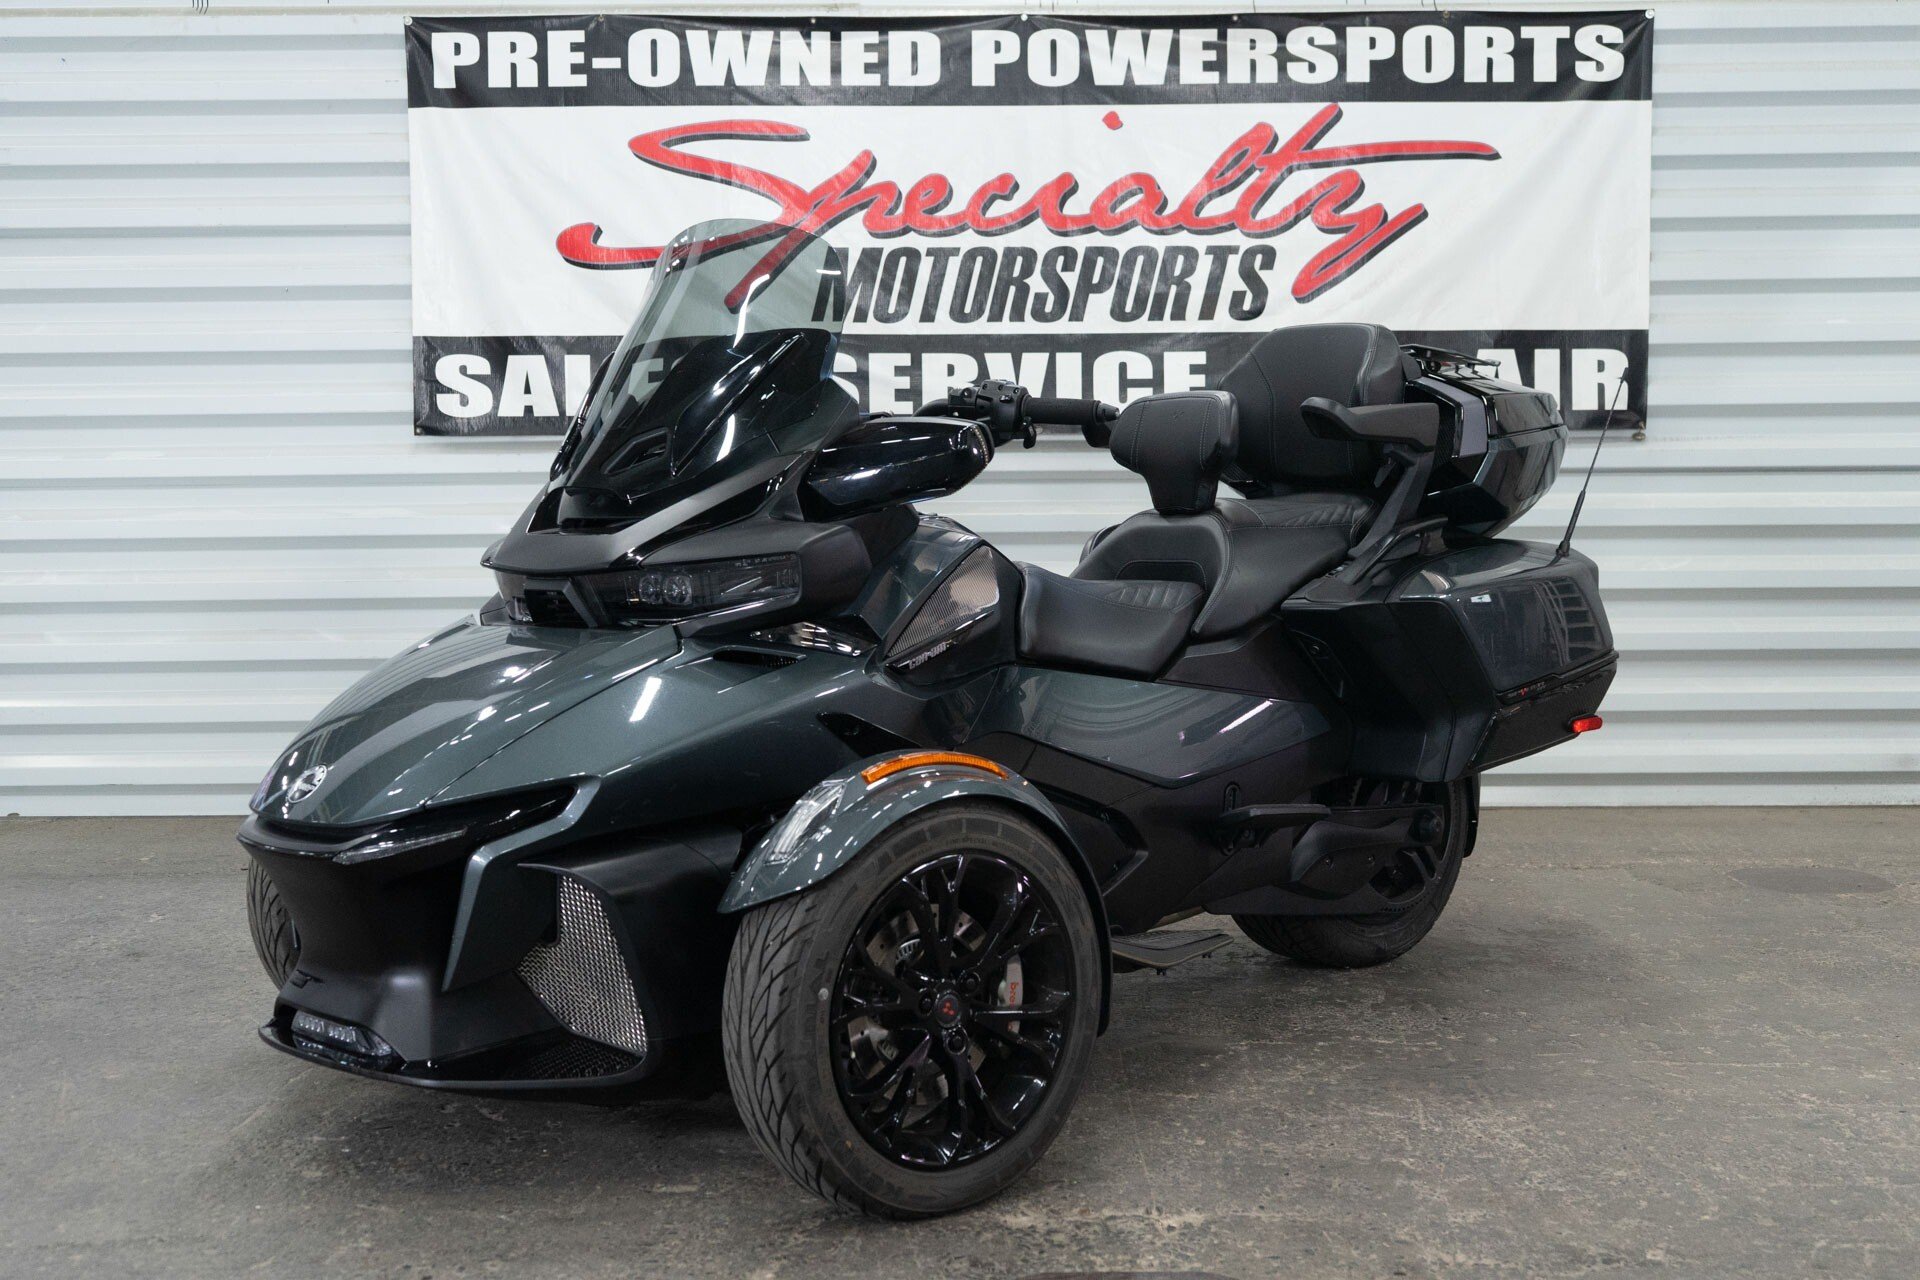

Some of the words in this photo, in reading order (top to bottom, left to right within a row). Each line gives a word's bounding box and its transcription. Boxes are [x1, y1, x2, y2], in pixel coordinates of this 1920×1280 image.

[431, 28, 941, 89] PRE-OWNED
[971, 25, 1625, 88] POWERSPORTS
[555, 102, 1502, 314] Specialty
[811, 245, 1277, 324] MOTORSPORTS
